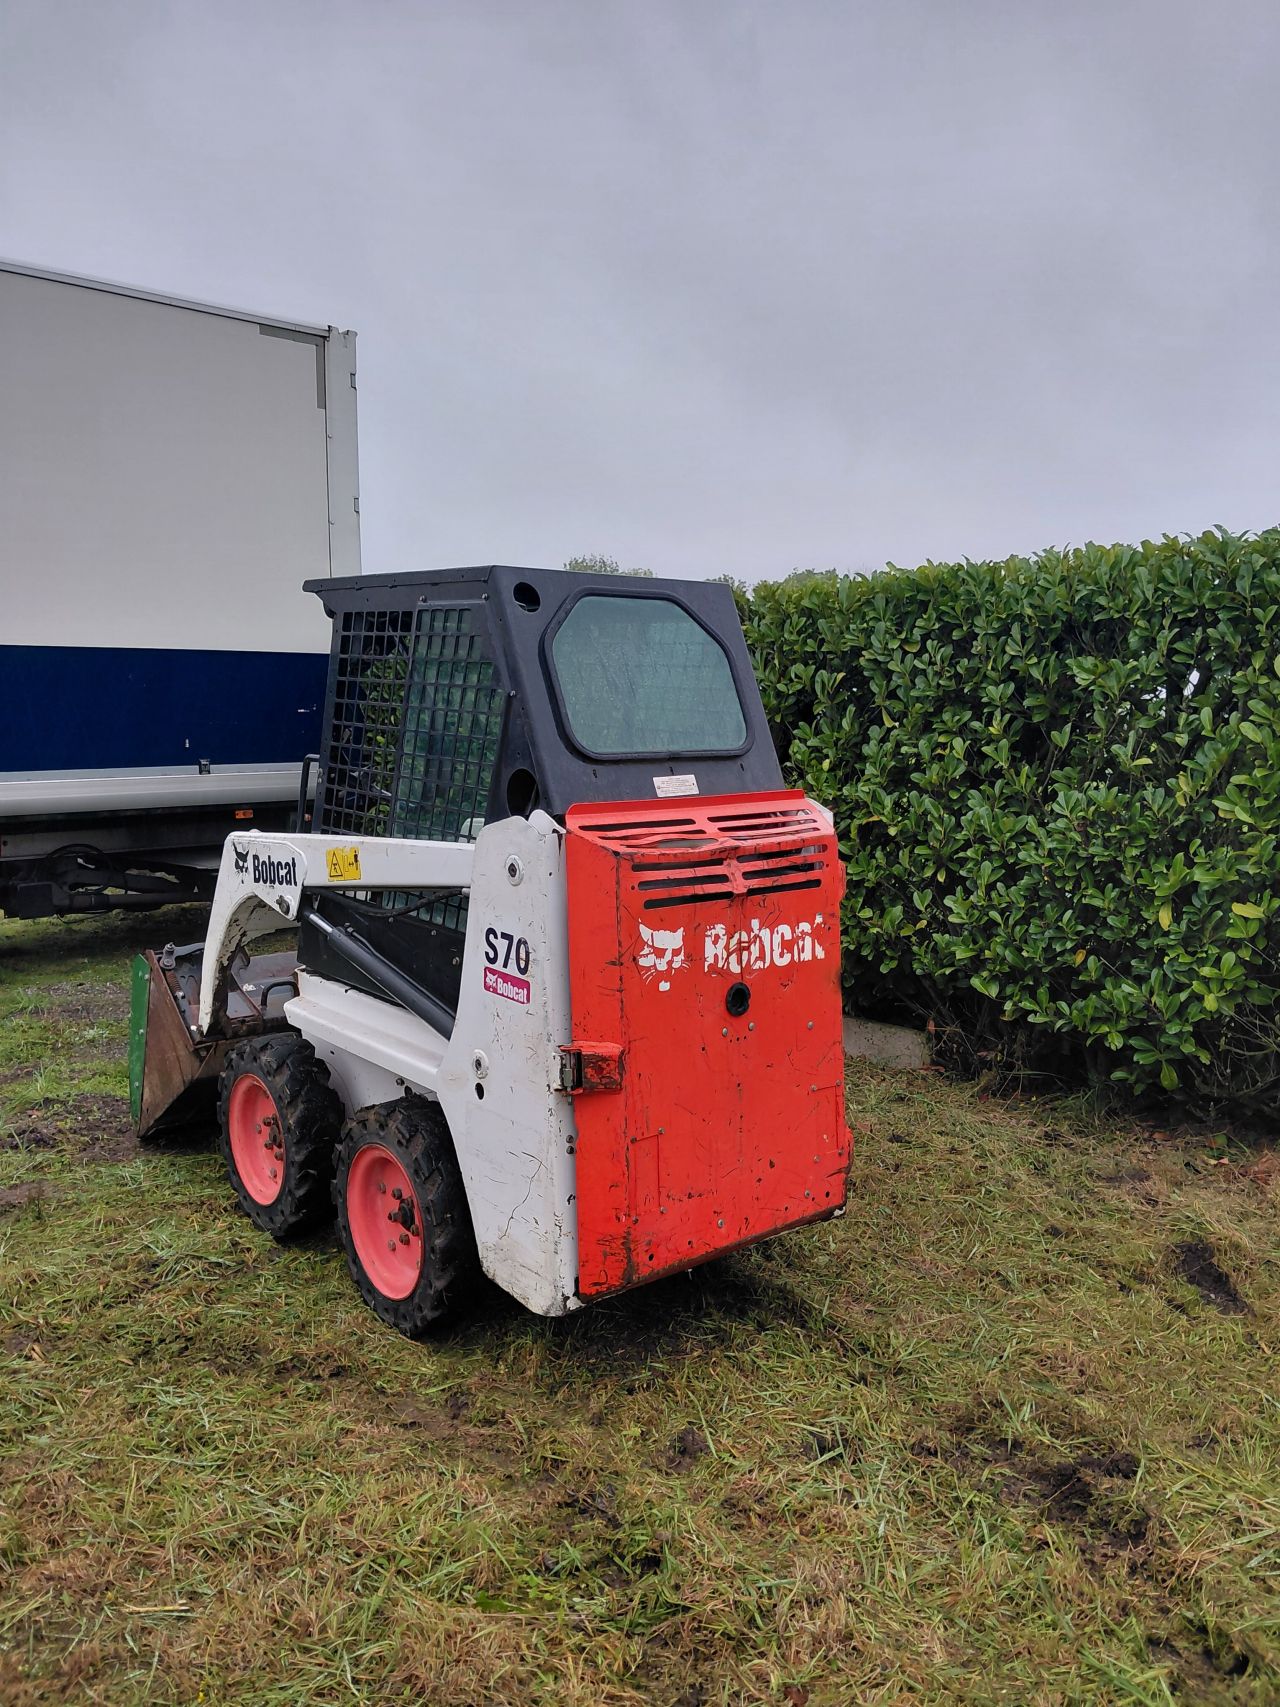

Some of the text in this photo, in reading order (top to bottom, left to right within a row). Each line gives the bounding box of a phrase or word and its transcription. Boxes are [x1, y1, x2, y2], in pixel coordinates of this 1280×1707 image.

[252, 854, 298, 887] Bobcat
[484, 927, 530, 976] S70
[497, 978, 528, 1004] Bobcat
